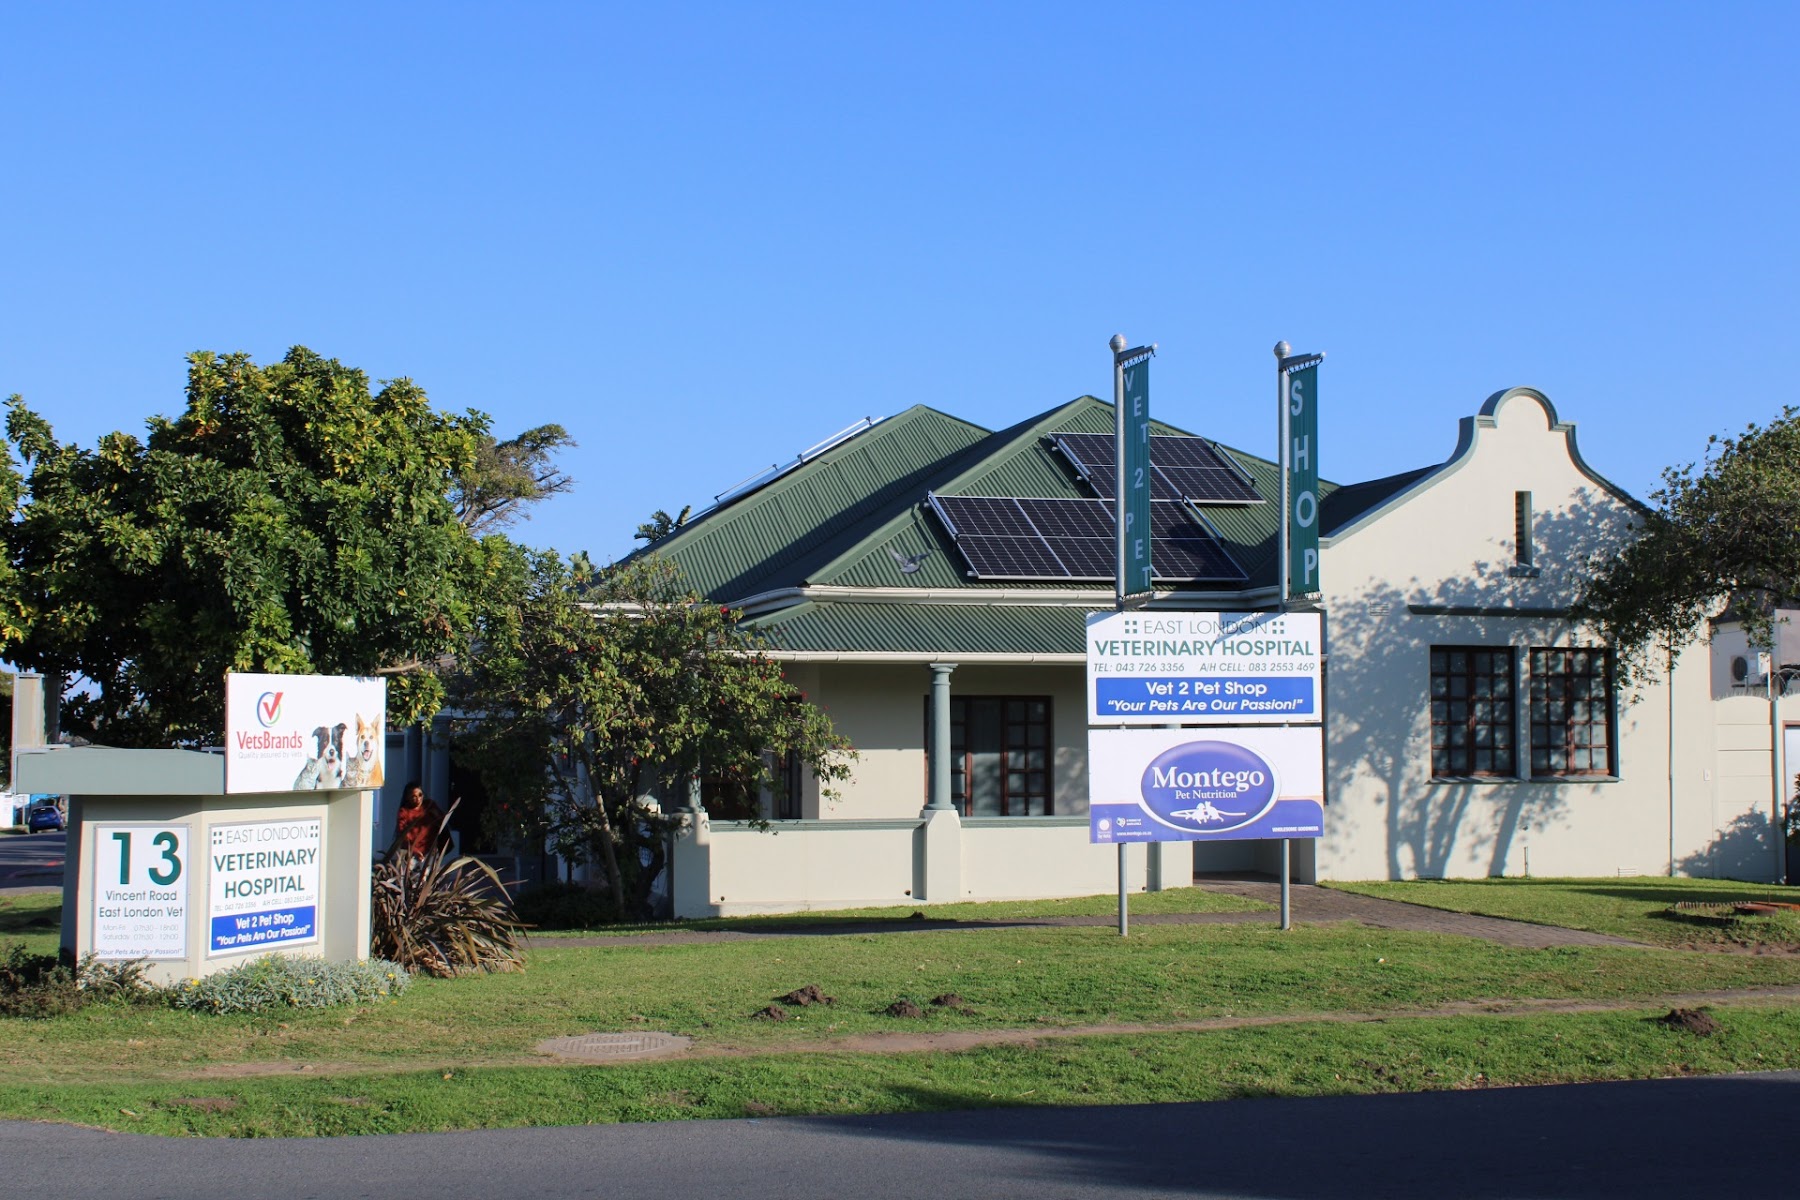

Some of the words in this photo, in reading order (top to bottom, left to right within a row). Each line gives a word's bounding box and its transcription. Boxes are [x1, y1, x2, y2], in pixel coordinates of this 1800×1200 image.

[1124, 370, 1148, 444] VET
[1134, 467, 1144, 489] 2
[1291, 379, 1318, 585] SHOP
[1126, 512, 1151, 587] PET
[1144, 620, 1183, 634] EAST
[1190, 620, 1268, 635] LONDON
[1094, 640, 1217, 656] VETERINARY
[1222, 640, 1314, 656] HOSPITAL
[1094, 662, 1113, 673] TEL:
[1115, 662, 1135, 672] 043
[1138, 662, 1157, 672] 726
[1160, 662, 1185, 672] 3356
[1199, 662, 1217, 672] A/H
[1219, 662, 1246, 672] CELL:
[1248, 662, 1267, 672] 083
[1270, 662, 1294, 672] 2553
[1296, 662, 1315, 672] 469
[1145, 681, 1174, 695] Vet
[1178, 681, 1189, 695] 2
[1194, 681, 1220, 695] Pet
[1224, 681, 1268, 697] Shop
[1108, 699, 1146, 712] “Your
[1149, 699, 1179, 712] Pets
[1181, 699, 1207, 711] Are
[1211, 699, 1238, 711] Our
[1240, 698, 1303, 711] Passion!”
[236, 730, 303, 750] VetsBrands
[1152, 766, 1265, 792] Montego
[1175, 790, 1191, 799] Pet
[1192, 789, 1237, 799] Nutrition
[226, 829, 253, 844] EAST
[257, 826, 308, 842] LONDON
[112, 831, 182, 886] 13
[213, 848, 317, 872] VETERINARY
[106, 890, 146, 901] Vincent
[149, 890, 177, 901] Road
[225, 875, 305, 899] HOSPITAL
[99, 907, 120, 917] East
[124, 907, 163, 917] London
[166, 906, 183, 917] Vet
[235, 917, 250, 929] Vet
[251, 916, 257, 928] 2
[259, 914, 272, 927] Pet
[273, 913, 295, 925] Shop
[236, 933, 252, 943] Pets
[252, 932, 265, 941] Are
[266, 929, 280, 939] Our
